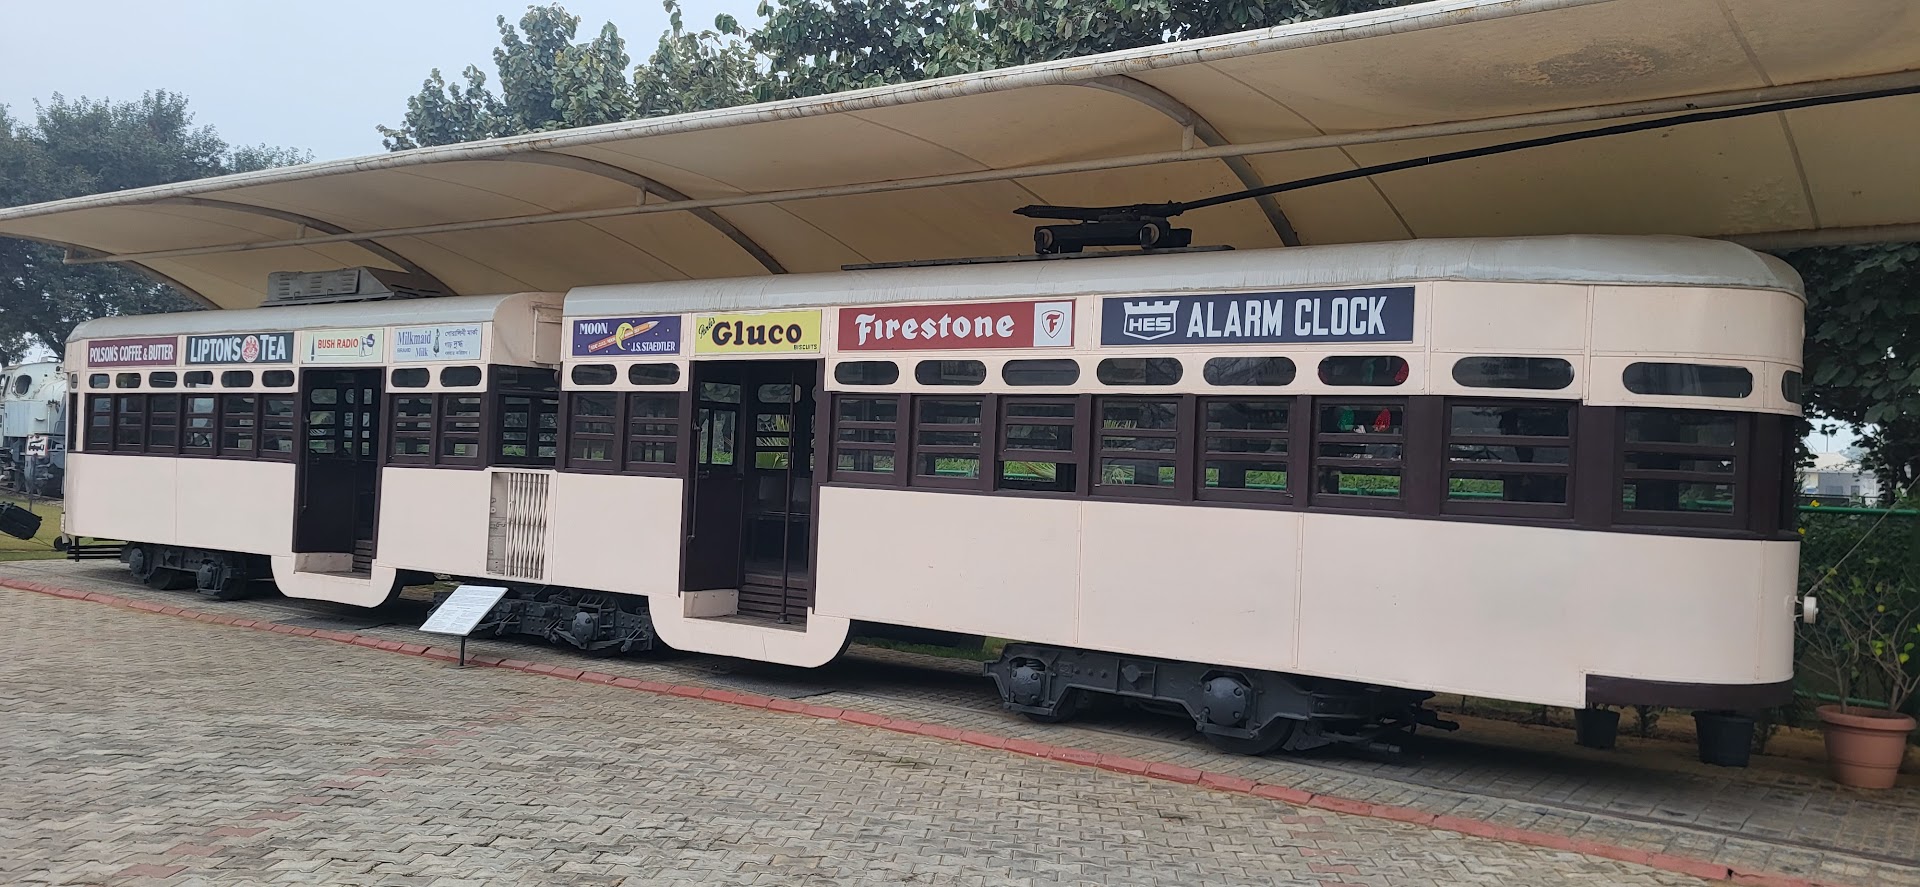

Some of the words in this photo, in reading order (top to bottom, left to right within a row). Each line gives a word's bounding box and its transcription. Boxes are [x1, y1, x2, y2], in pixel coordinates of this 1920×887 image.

[1129, 316, 1171, 332] HES
[1186, 299, 1283, 338] ALARM
[1294, 296, 1387, 336] CLOCK
[579, 322, 608, 335] MOON
[711, 320, 803, 346] Gluco
[855, 313, 1015, 346] Firestone
[317, 339, 335, 349] BUSH
[337, 338, 359, 349] RADIO
[397, 330, 432, 346] Milkmaid
[90, 345, 119, 363] POLSON'S
[120, 344, 143, 362] COFFEE
[143, 347, 148, 361] &
[148, 344, 174, 361] BUTTER
[190, 336, 241, 362] LIPTON'S
[260, 335, 287, 360] TEA
[415, 347, 429, 357] Milk
